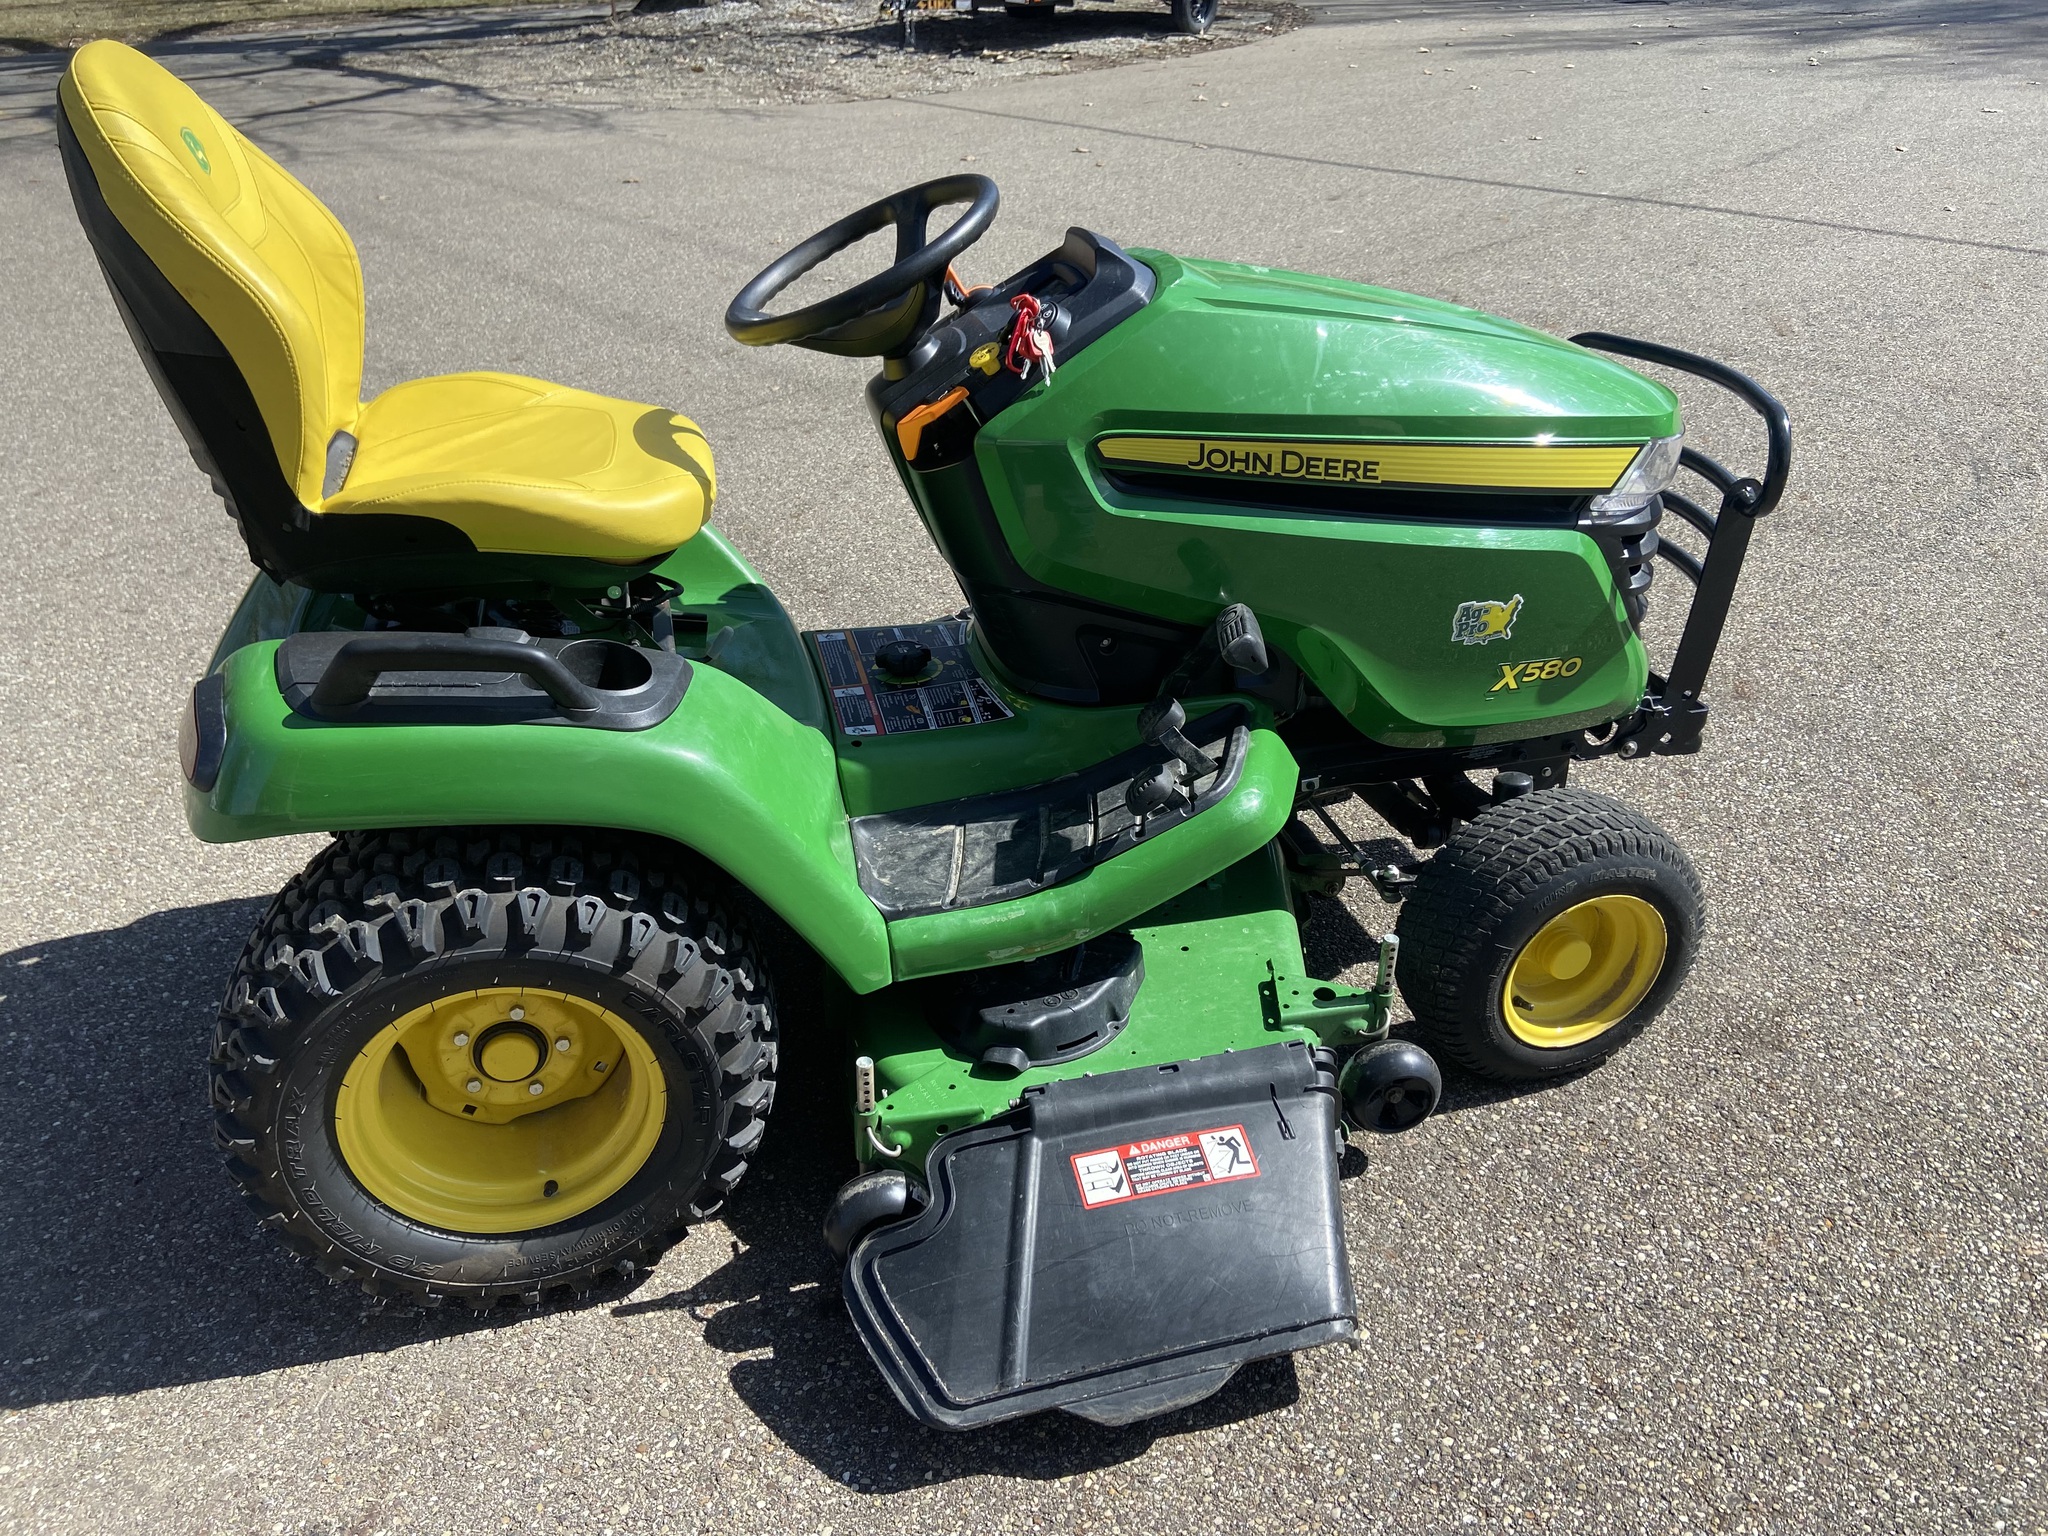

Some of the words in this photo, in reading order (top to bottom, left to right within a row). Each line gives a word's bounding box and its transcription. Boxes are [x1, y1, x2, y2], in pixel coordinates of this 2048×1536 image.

[1188, 443, 1272, 473] JOHN
[1281, 450, 1380, 480] DEERE
[1456, 622, 1488, 638] Pro
[1488, 656, 1583, 692] X580
[1141, 1136, 1190, 1152] DANGER
[1124, 1219, 1146, 1236] DO
[1151, 1212, 1182, 1229] NOT
[1187, 1199, 1254, 1223] REMOVE
[557, 1231, 606, 1256] HIGHWAY
[506, 1250, 557, 1267] SERVICE
